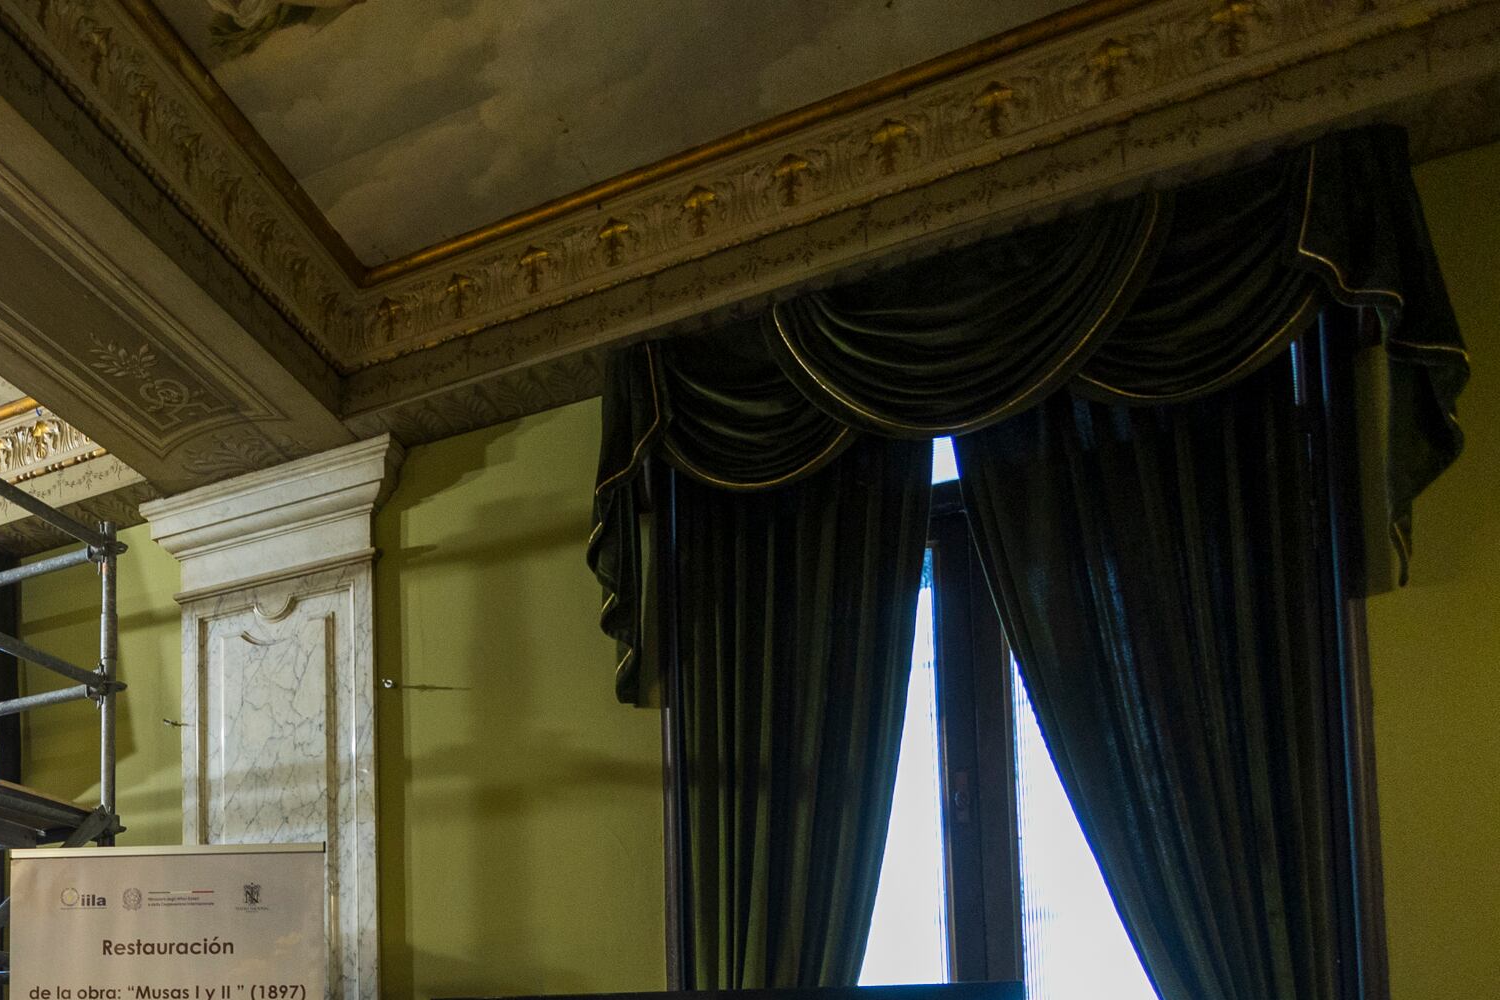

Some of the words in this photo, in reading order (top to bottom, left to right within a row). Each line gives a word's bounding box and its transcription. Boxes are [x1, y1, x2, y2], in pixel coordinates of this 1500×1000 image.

[81, 894, 106, 907] iila
[102, 937, 234, 956] Restauración
[29, 986, 51, 999] de
[57, 985, 71, 999] la
[77, 985, 121, 1000] obra:
[128, 985, 189, 1000] “Musas
[196, 986, 199, 999] I
[222, 985, 230, 999] II
